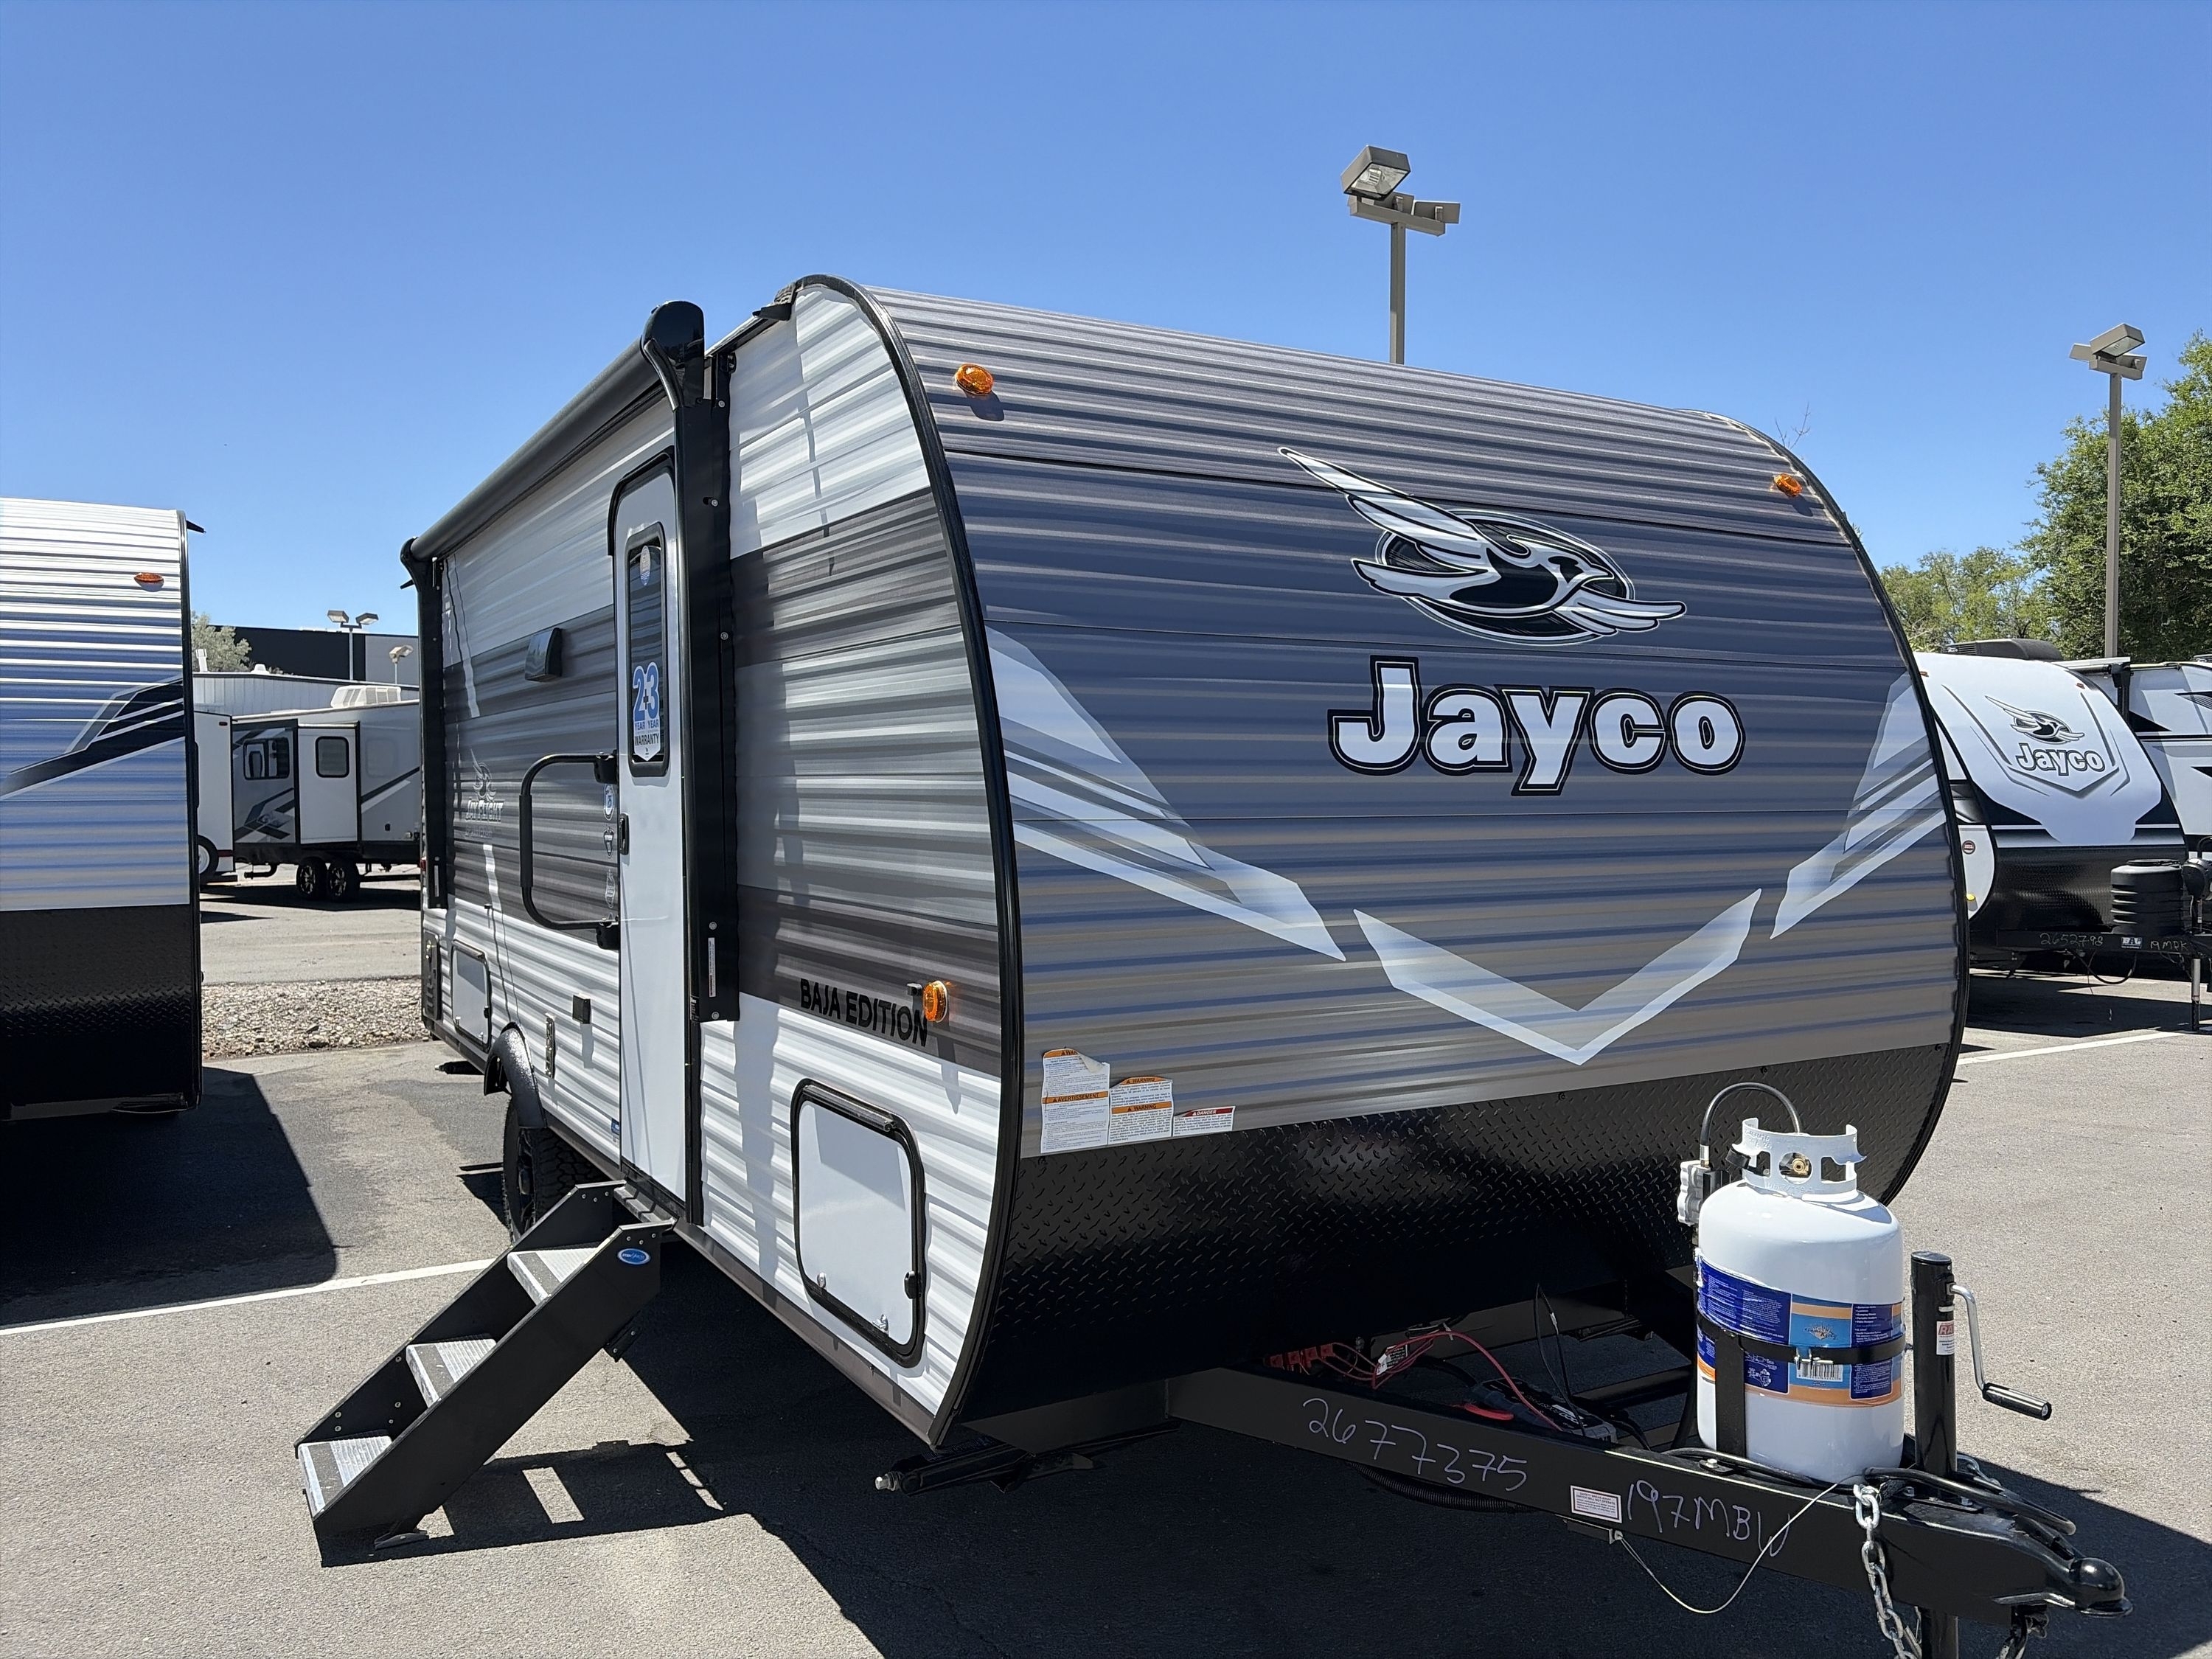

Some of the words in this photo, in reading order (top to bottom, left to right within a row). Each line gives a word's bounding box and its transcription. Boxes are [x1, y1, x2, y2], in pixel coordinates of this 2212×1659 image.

[635, 722, 645, 731] YEAR
[647, 719, 658, 728] YEAR
[635, 733, 659, 746] WARRANTY
[1327, 655, 1746, 796] Jayco
[2016, 742, 2105, 776] Jayco
[800, 978, 841, 1020] BAJA
[846, 991, 928, 1047] EDITION
[1057, 1093, 1099, 1102] AVERTISSEMENT
[1302, 1397, 1528, 1492] 2677375
